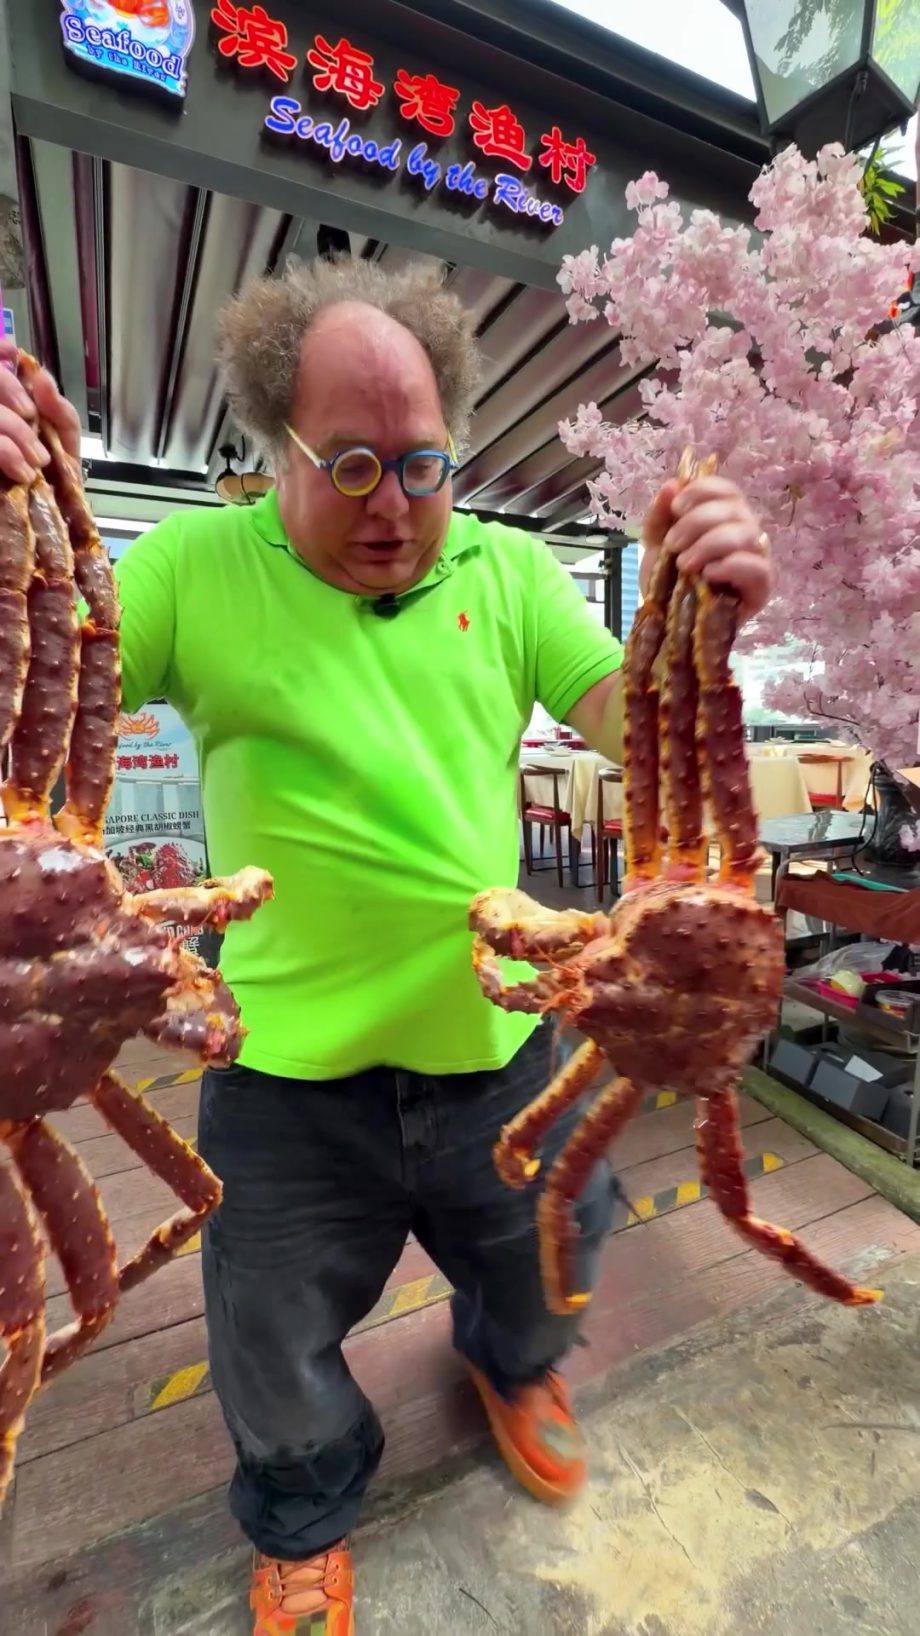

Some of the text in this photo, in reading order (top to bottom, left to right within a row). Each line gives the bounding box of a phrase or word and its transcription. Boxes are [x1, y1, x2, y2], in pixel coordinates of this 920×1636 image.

[64, 14, 182, 80] Seafood
[87, 45, 103, 59] by
[211, 0, 596, 193] 滨海湾渔村
[265, 96, 564, 226] Seafood by the River
[117, 753, 179, 769] 海湾渔村
[105, 810, 199, 824] APORE CLASSIC DISH
